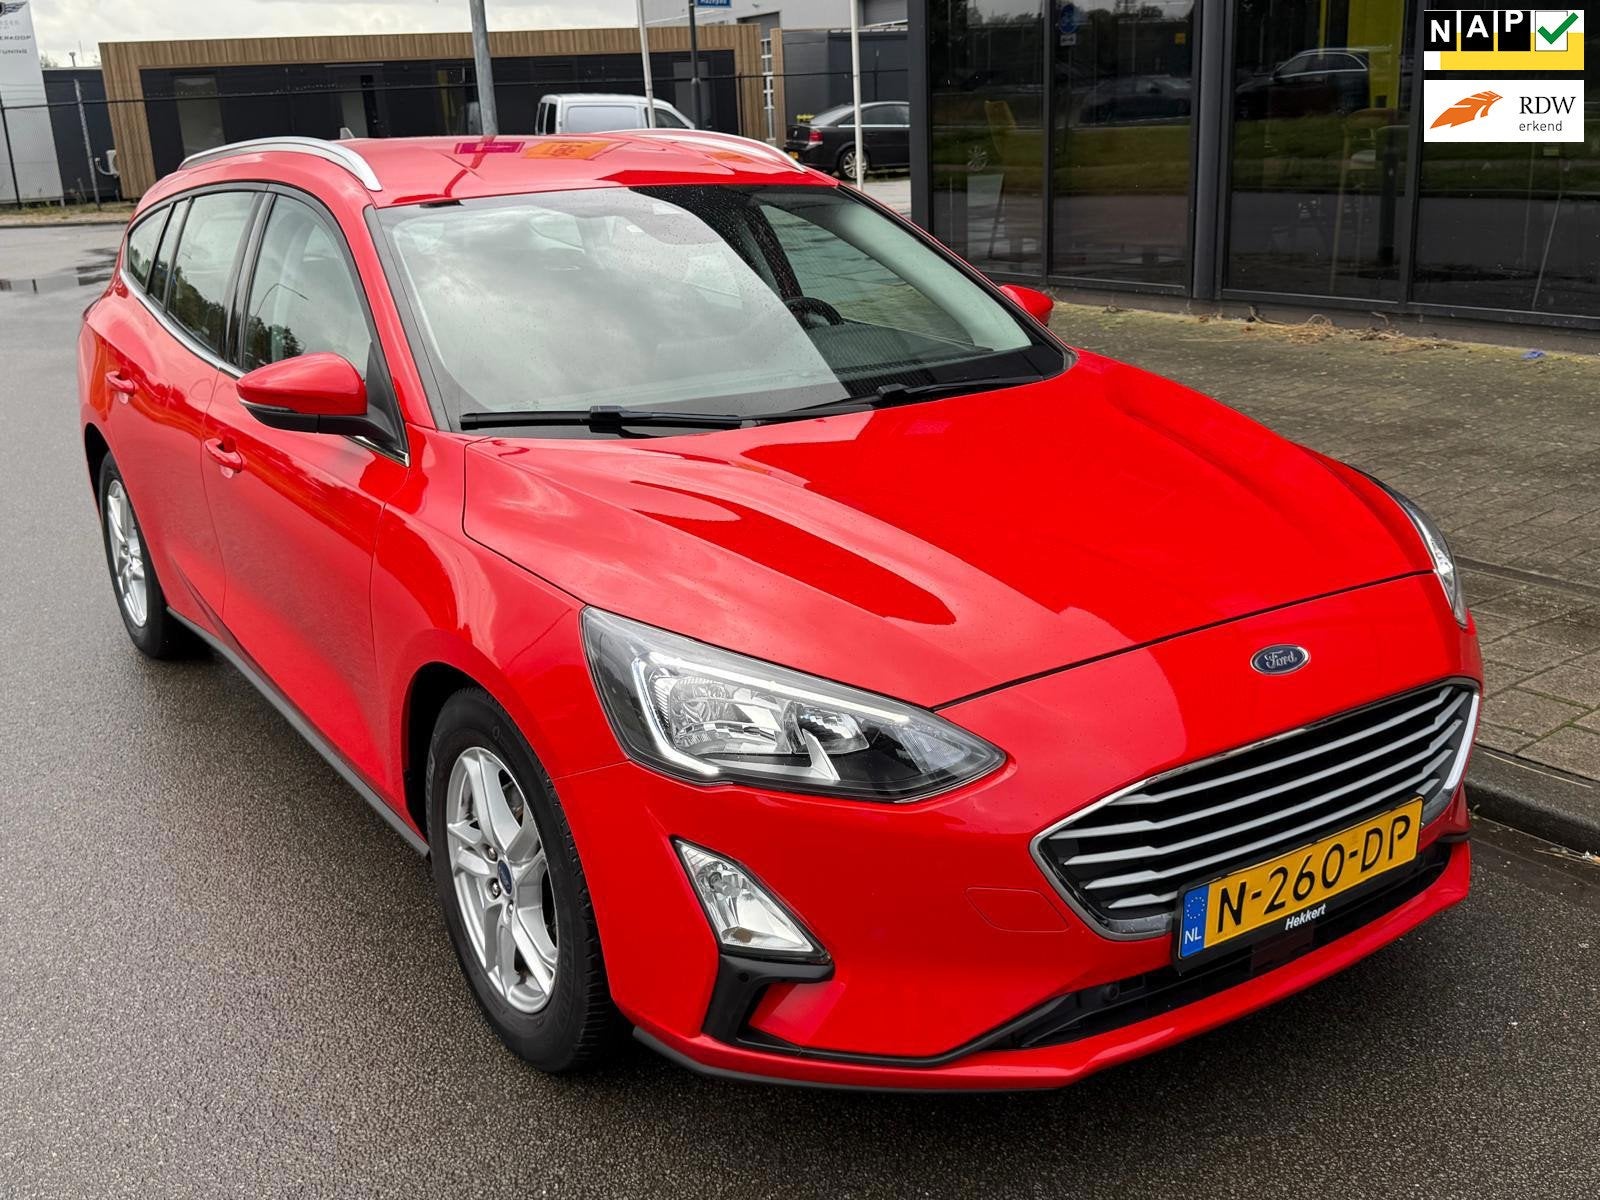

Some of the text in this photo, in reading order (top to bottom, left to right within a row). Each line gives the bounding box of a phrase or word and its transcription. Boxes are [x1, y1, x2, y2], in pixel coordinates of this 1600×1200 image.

[1263, 650, 1298, 669] Ford
[1216, 814, 1411, 933] N-260-DP
[1285, 903, 1327, 931] Hekkert
[1184, 926, 1202, 945] NL
